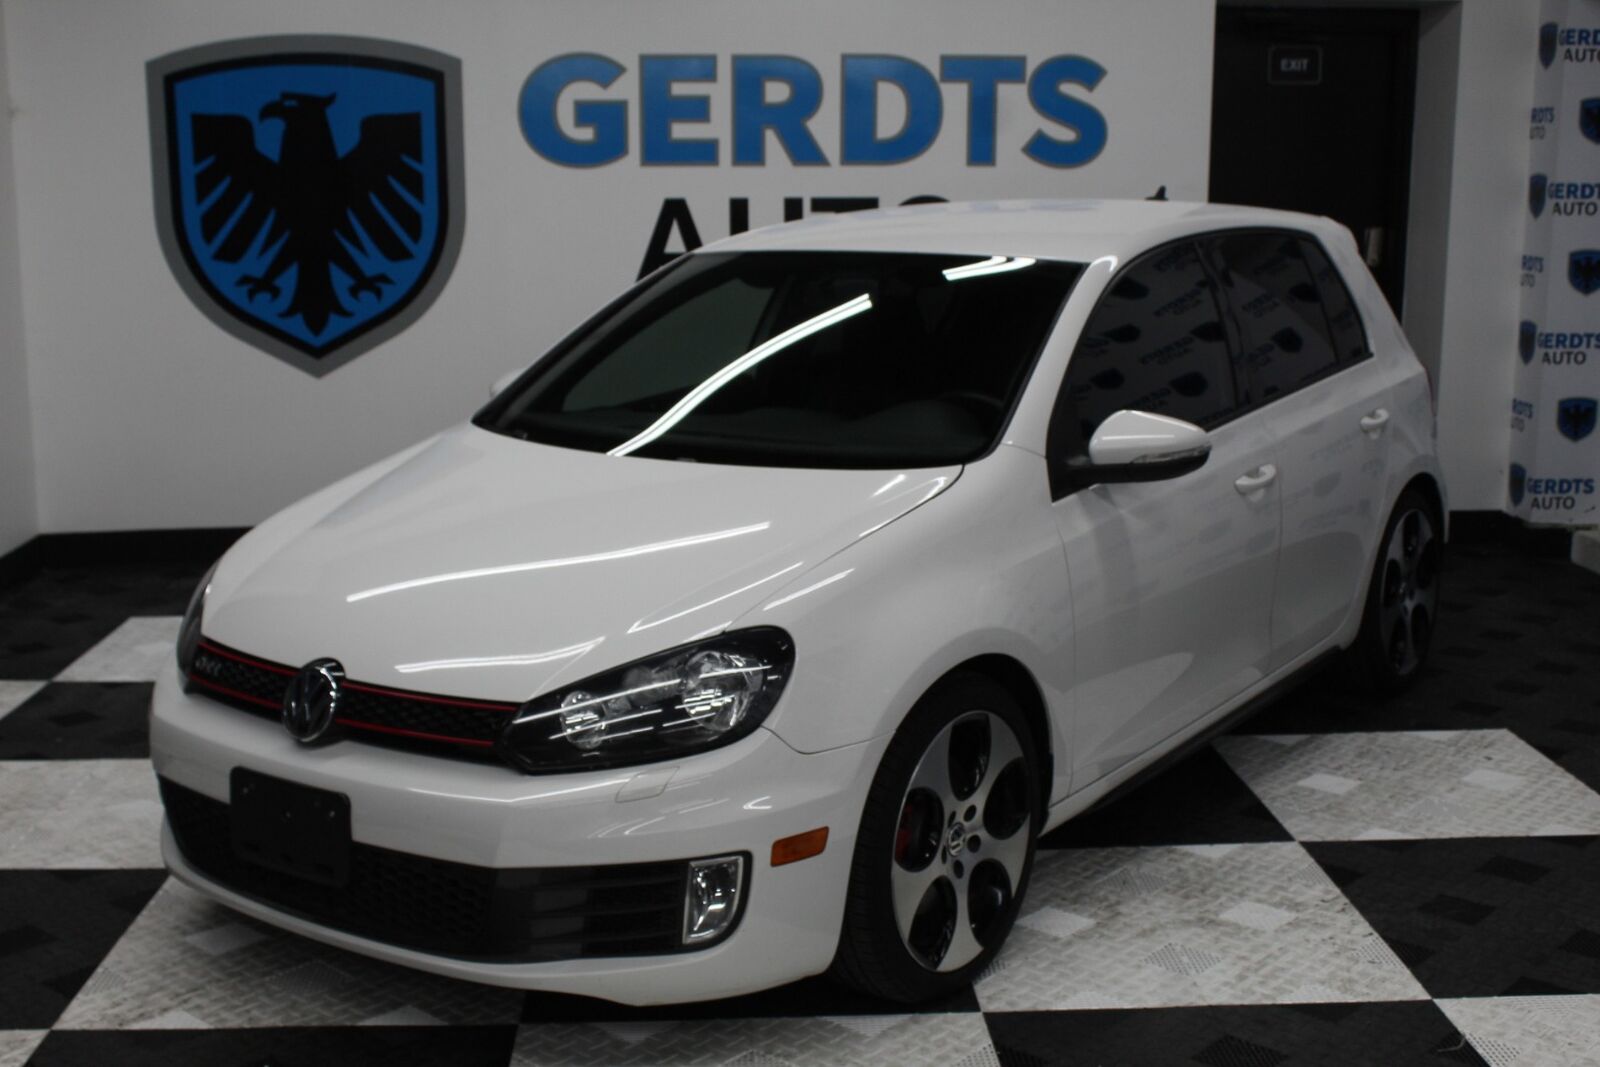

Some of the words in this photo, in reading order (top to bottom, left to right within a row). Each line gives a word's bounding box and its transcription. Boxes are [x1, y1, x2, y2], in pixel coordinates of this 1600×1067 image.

[1563, 47, 1600, 62] AUT
[1280, 57, 1309, 72] EXIT
[517, 51, 1107, 169] GERDTS
[1552, 201, 1598, 216] AUTO
[1542, 351, 1587, 365] AUTO
[1527, 478, 1594, 494] GERDTS
[1531, 496, 1576, 510] AUTO
